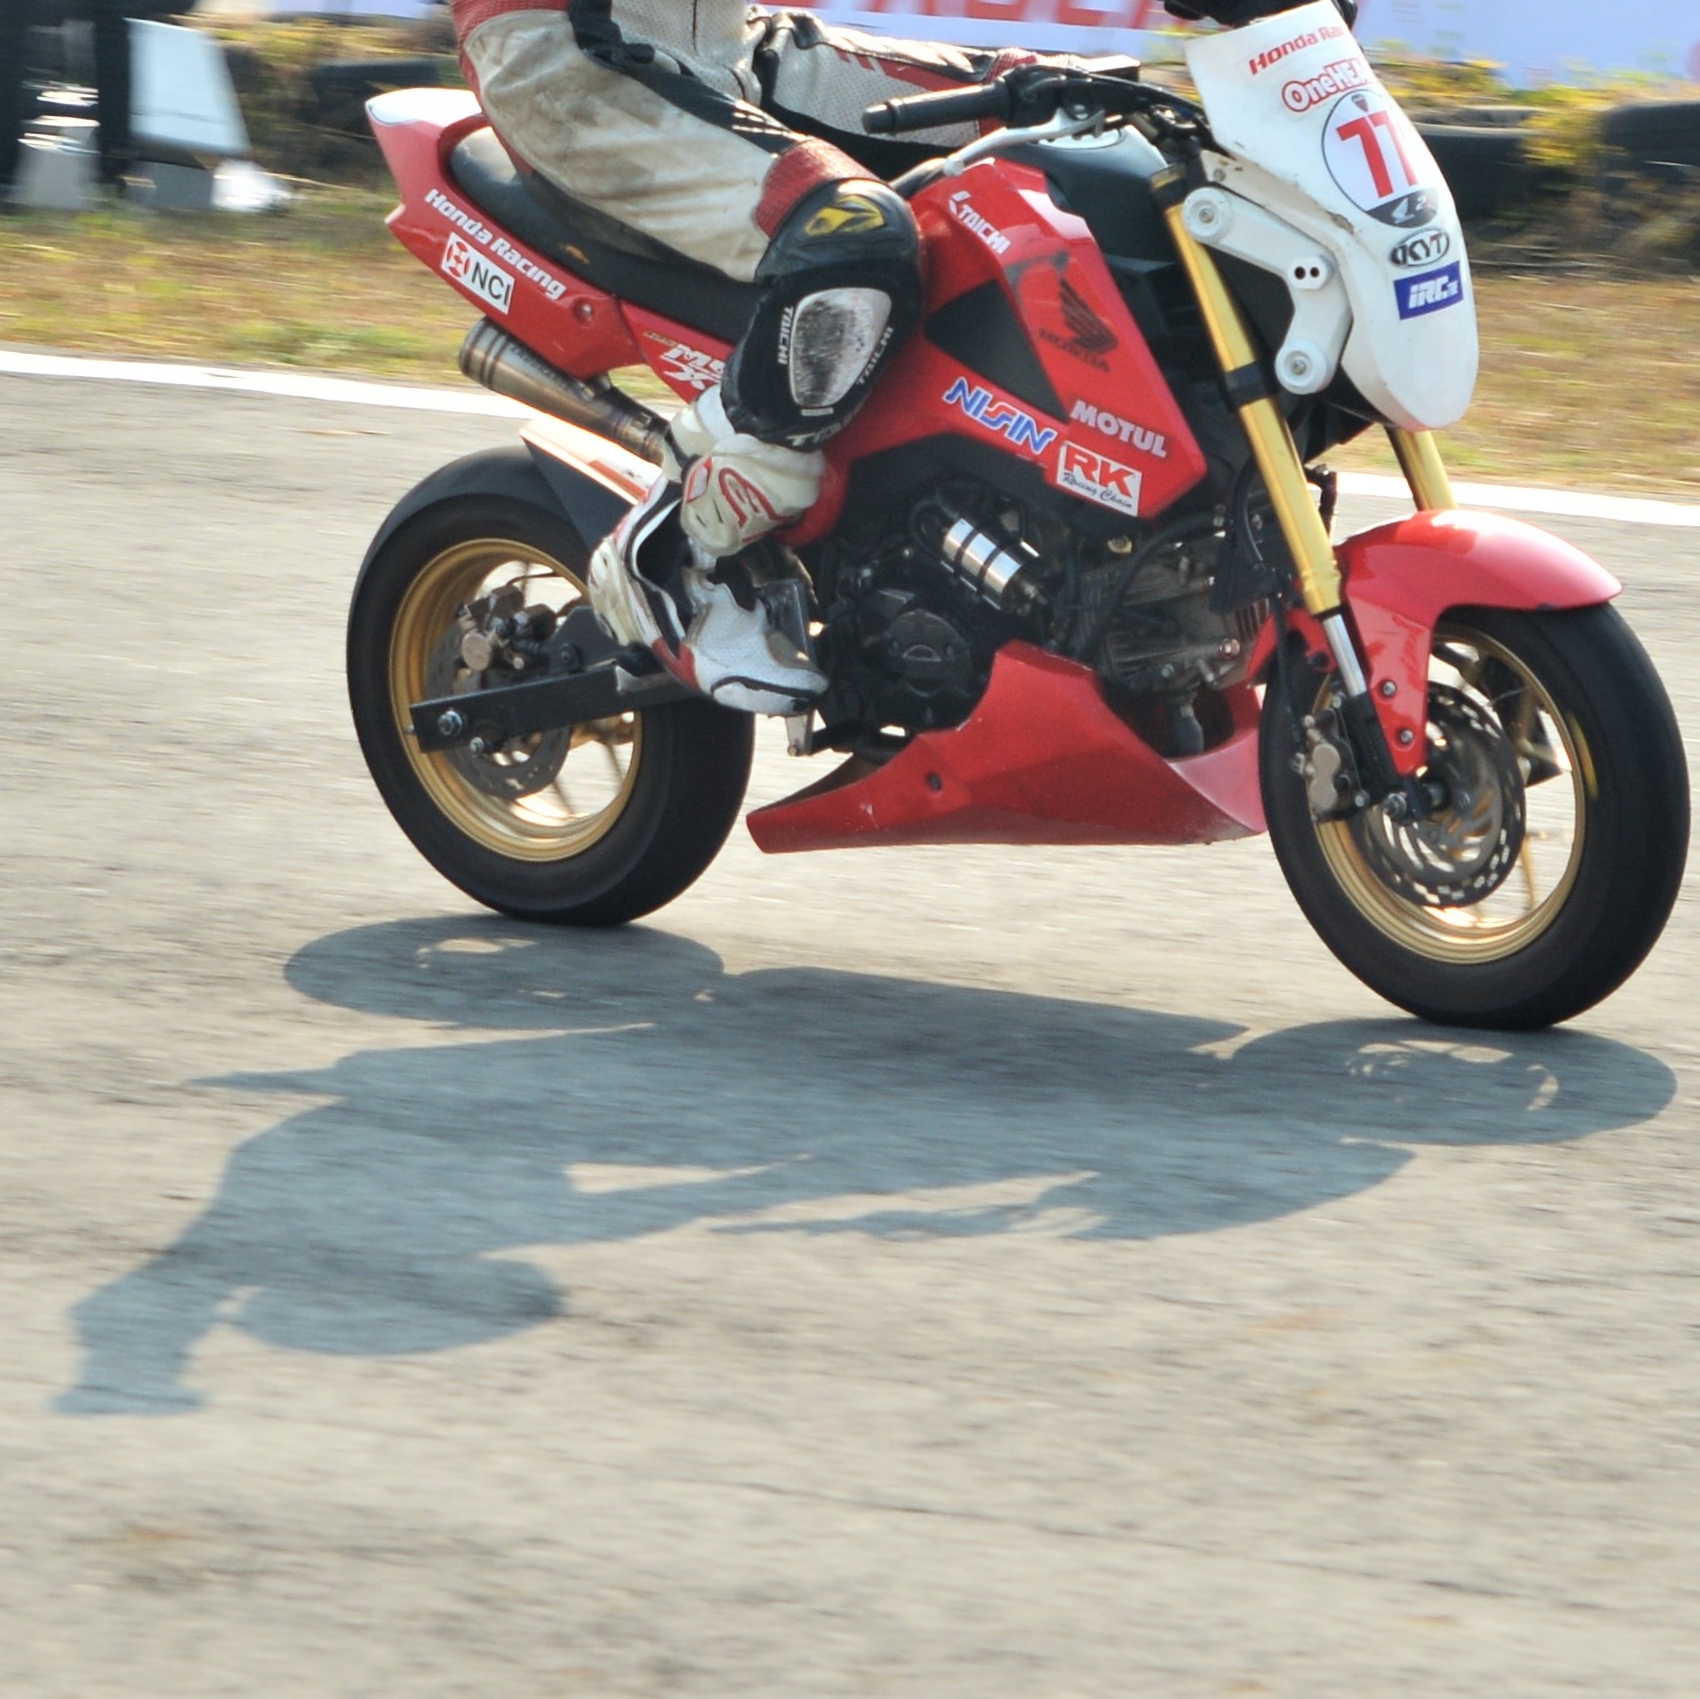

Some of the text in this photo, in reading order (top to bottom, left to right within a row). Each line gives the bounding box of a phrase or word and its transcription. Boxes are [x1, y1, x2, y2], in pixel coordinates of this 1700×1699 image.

[1248, 33, 1318, 75] Honda
[424, 188, 568, 301] Honda Racing
[956, 205, 1012, 255] TAICHI
[1398, 233, 1444, 265] KYT
[470, 260, 513, 307] NCI
[777, 307, 795, 366] TAICHI
[1069, 399, 1168, 459] MOTUL
[1062, 471, 1098, 496] Racing
[1063, 445, 1134, 499] RK
